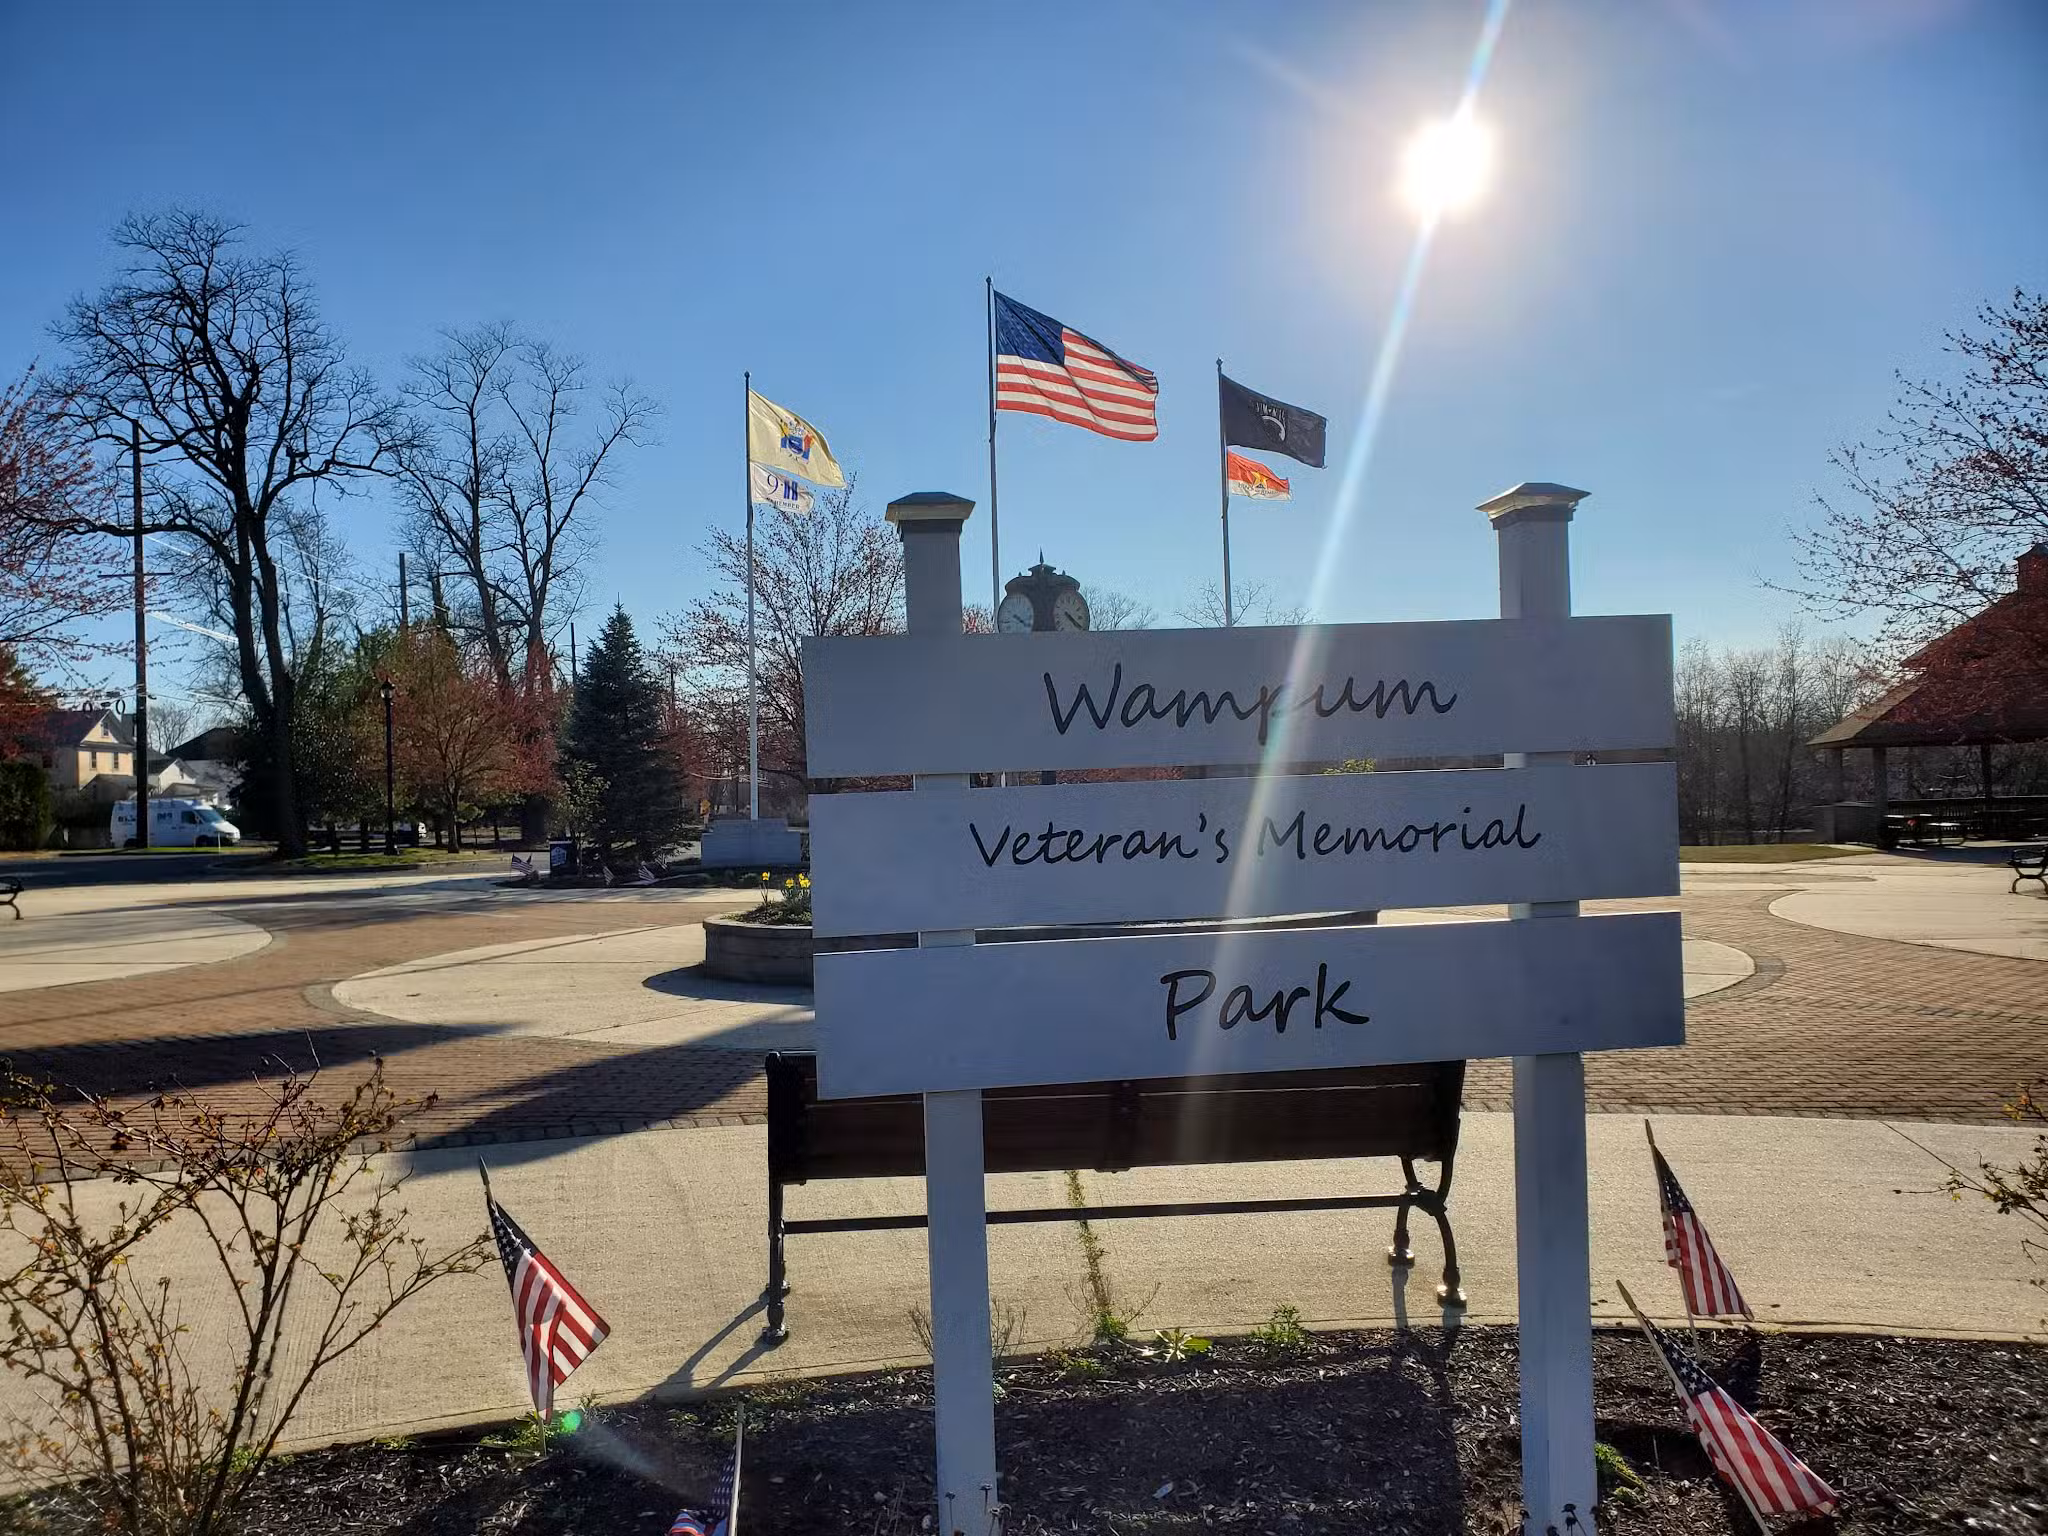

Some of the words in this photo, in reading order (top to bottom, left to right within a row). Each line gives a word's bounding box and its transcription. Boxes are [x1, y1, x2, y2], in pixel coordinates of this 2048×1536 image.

[1043, 662, 1458, 746] Wampum
[969, 812, 1229, 868] Veteran's
[1256, 803, 1542, 861] Memorial
[1160, 963, 1370, 1042] Park
